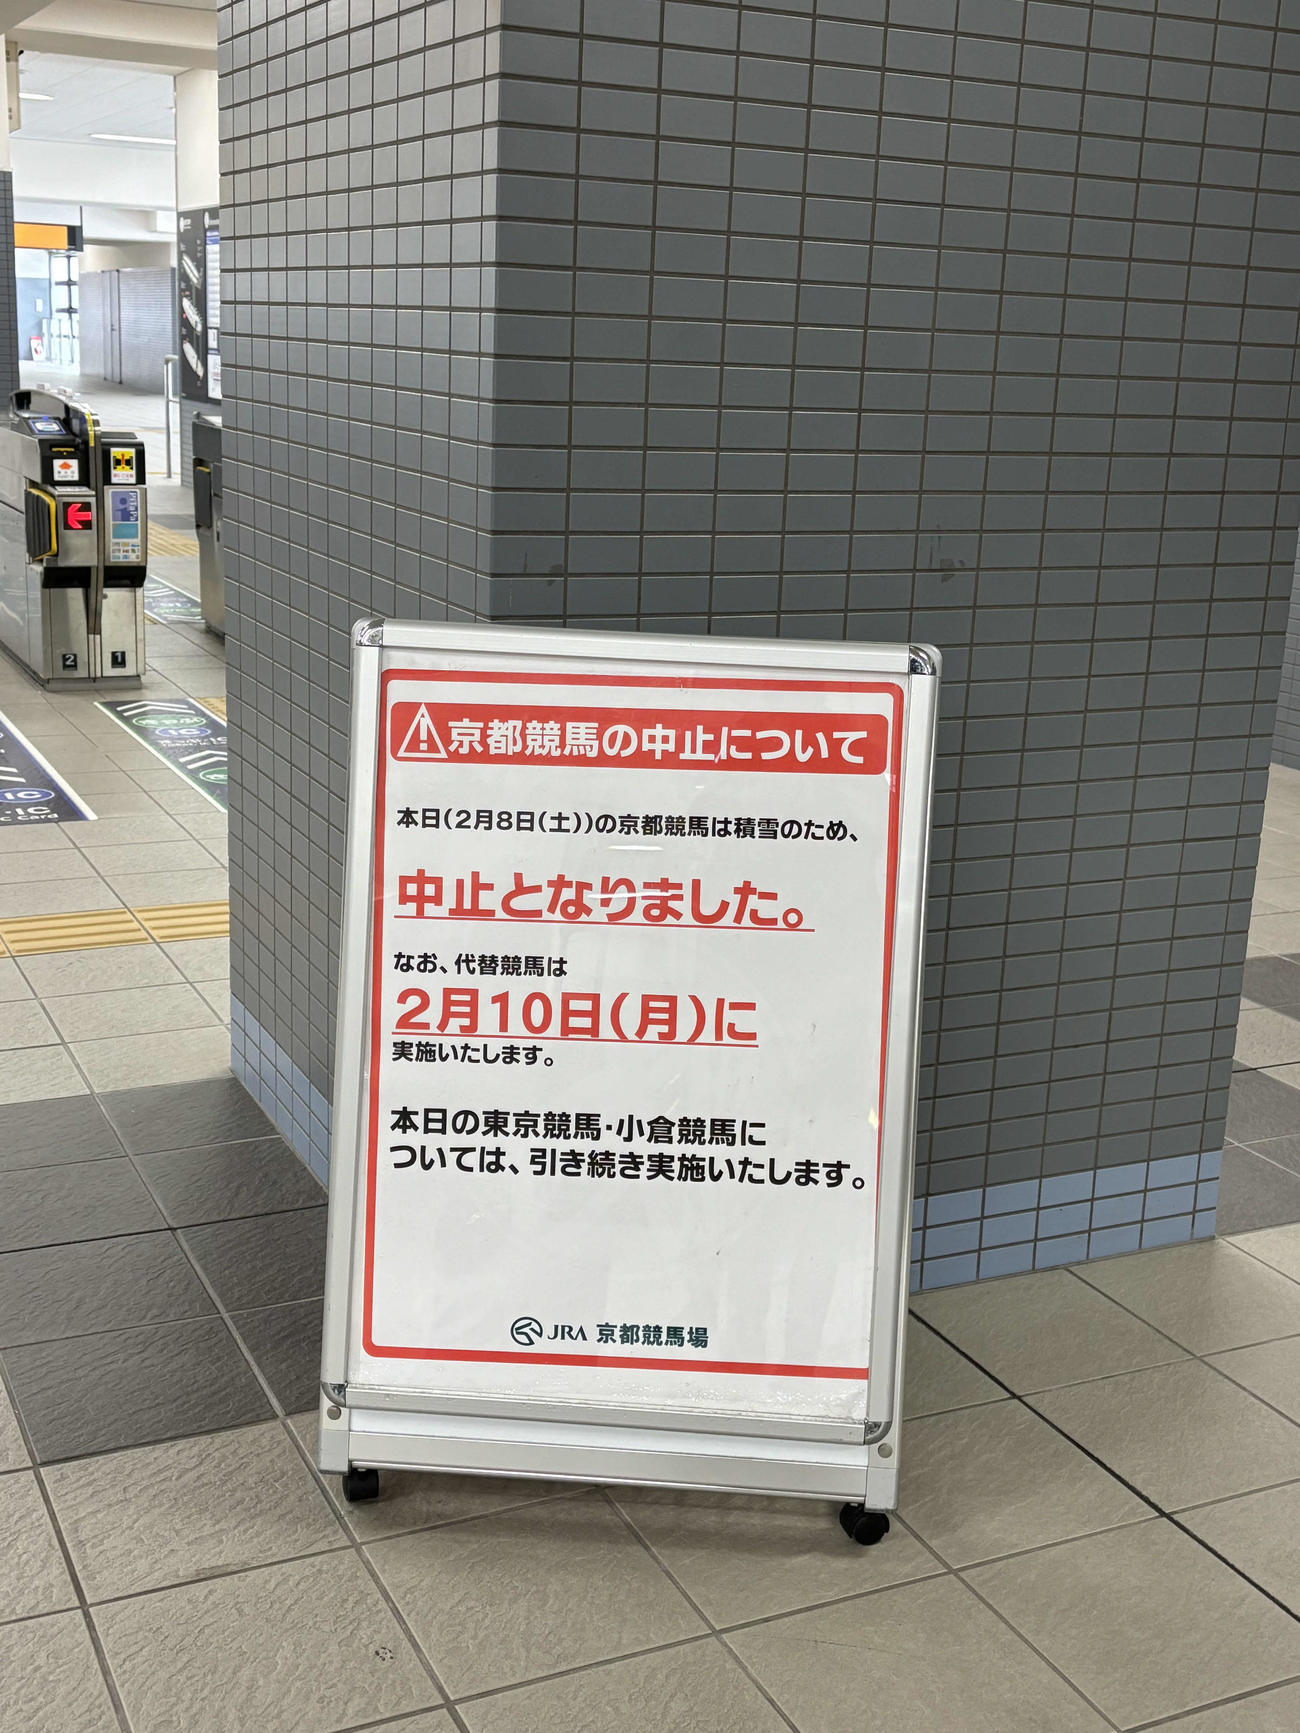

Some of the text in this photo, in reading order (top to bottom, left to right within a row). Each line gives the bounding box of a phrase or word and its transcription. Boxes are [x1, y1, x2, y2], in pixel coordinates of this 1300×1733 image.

[65, 654, 75, 665] 2
[115, 652, 122, 663] 1
[447, 718, 869, 765] 京都競馬の中止について
[4, 791, 42, 800] IC
[396, 806, 859, 842] 本日(2月8日(土))の京都競馬は積雪のため、
[398, 869, 804, 929] 中止となりました。
[393, 951, 568, 978] なお、代替競馬は
[395, 987, 758, 1042] 2月10日(月)に
[392, 1040, 554, 1067] 実施いたします。
[390, 1106, 767, 1147] 本日の東京競馬・小倉競馬に
[389, 1145, 865, 1190] ついては、引き続き実施いたします。
[547, 1323, 709, 1349] JRA 京都競馬場
